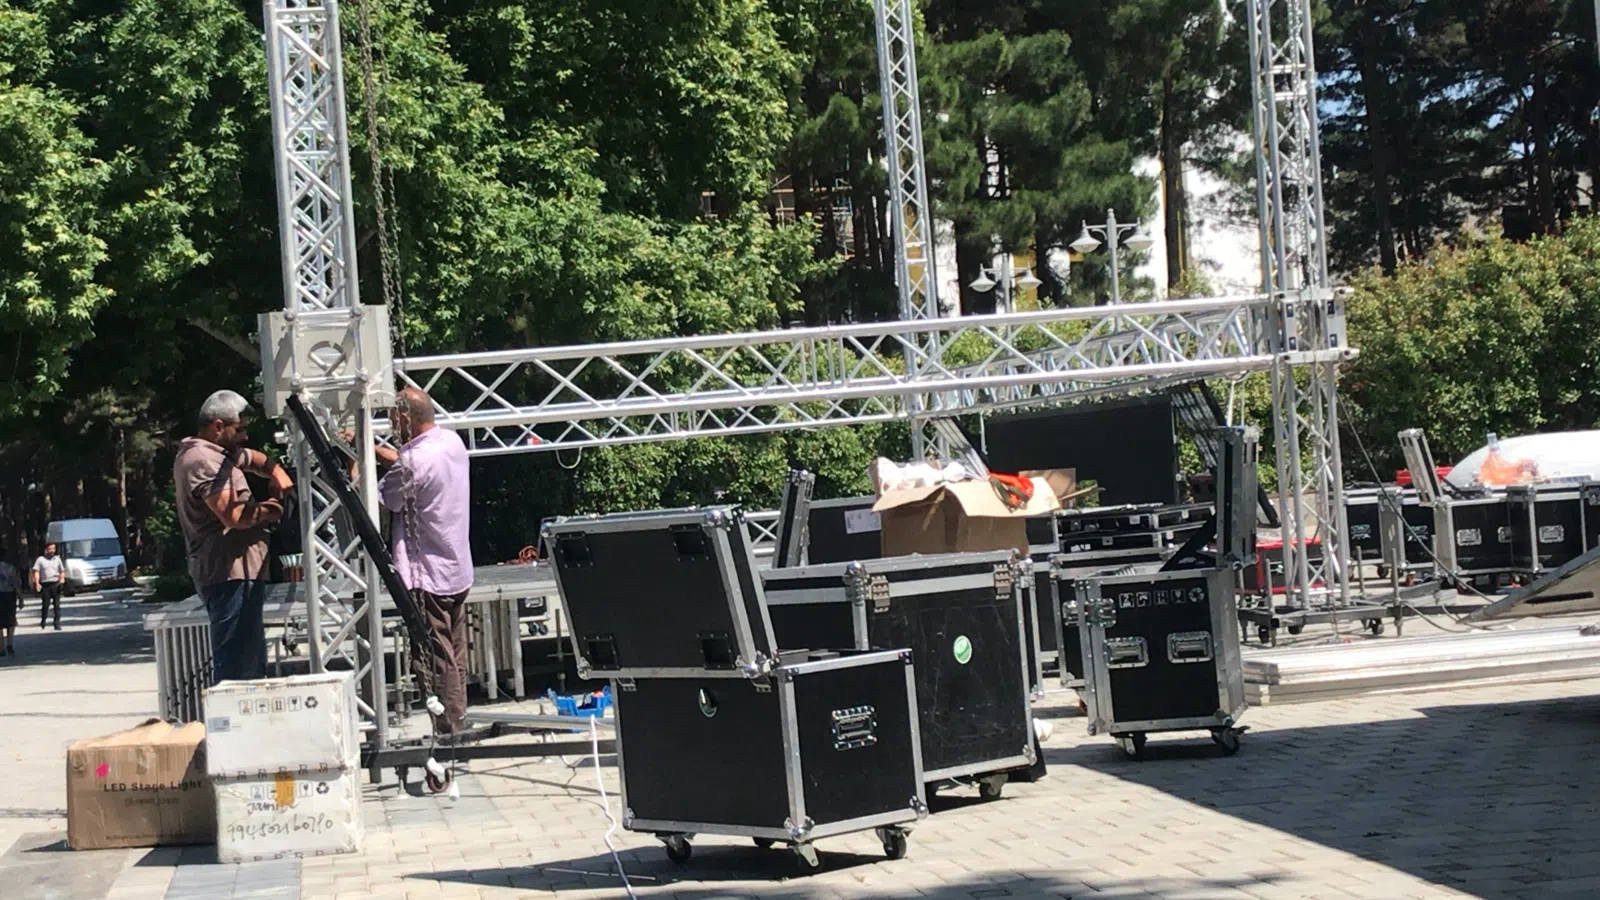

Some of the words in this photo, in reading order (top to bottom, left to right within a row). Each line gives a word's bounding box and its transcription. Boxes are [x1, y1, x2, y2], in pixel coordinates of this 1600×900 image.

[103, 783, 127, 792] LED
[131, 782, 166, 793] Stage
[170, 780, 203, 791] Light
